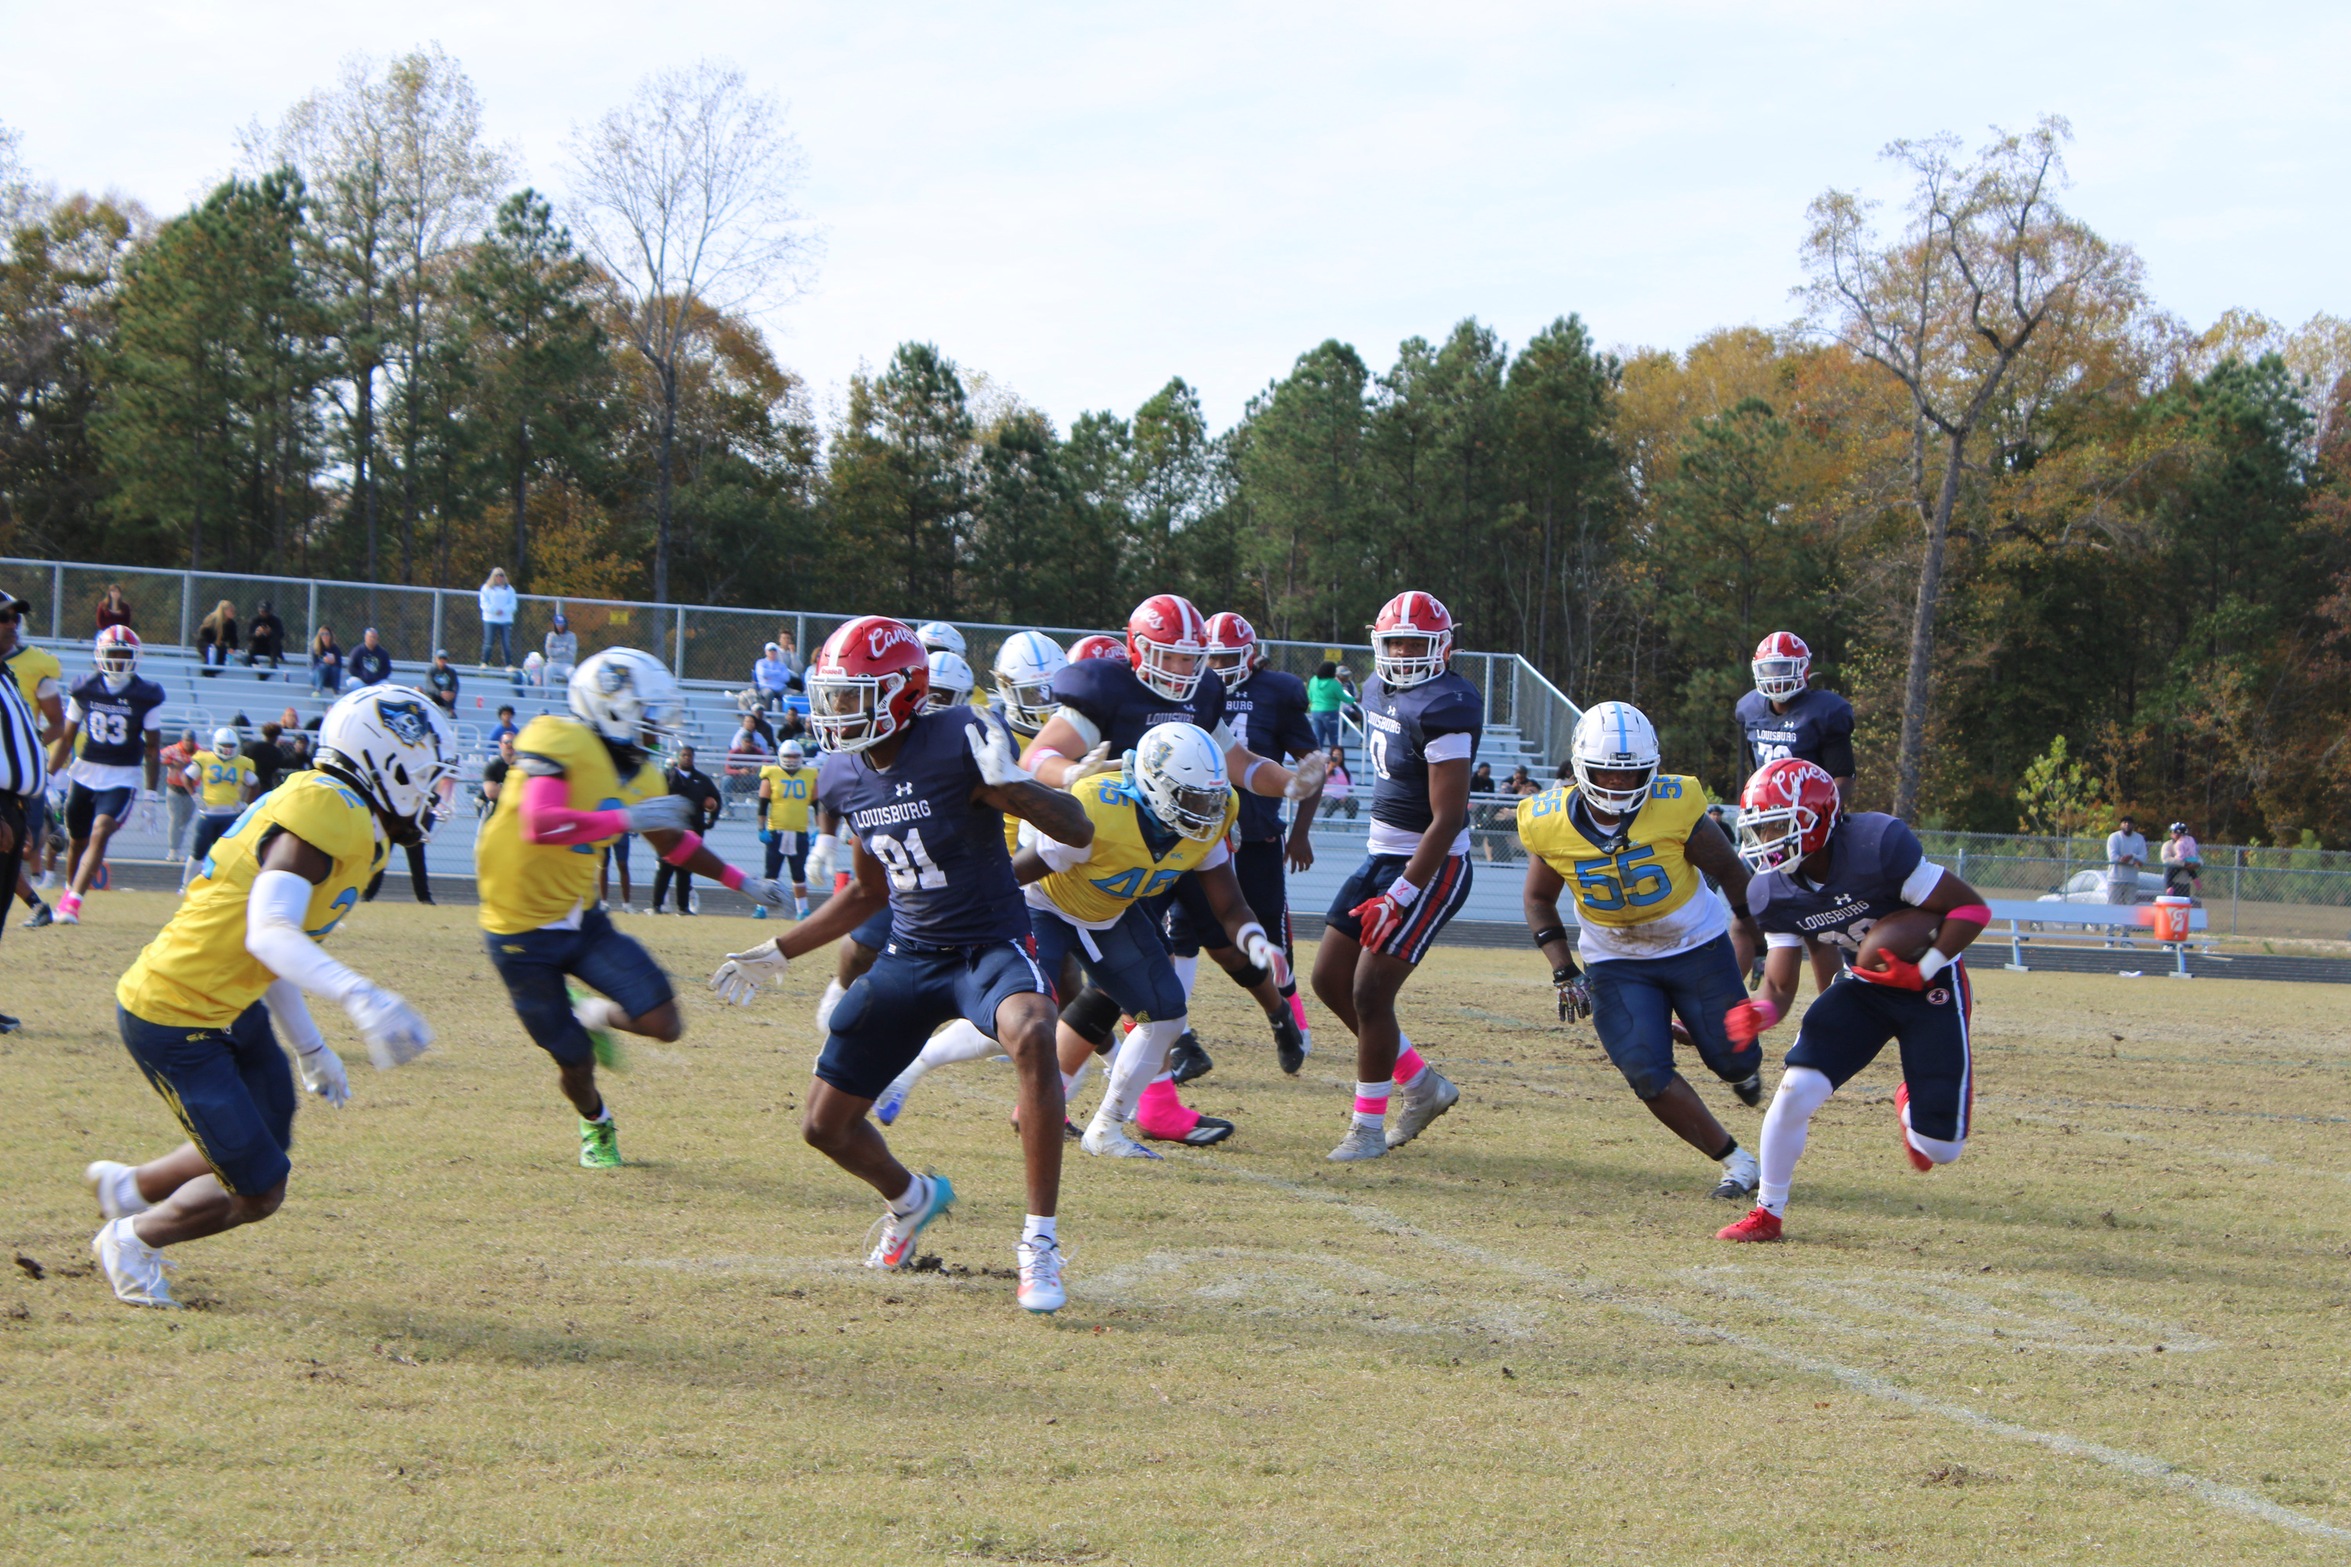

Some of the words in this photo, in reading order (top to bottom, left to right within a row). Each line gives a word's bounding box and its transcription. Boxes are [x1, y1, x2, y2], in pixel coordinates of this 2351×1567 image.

[89, 711, 128, 745] 83
[1756, 728, 1797, 743] LOUISBURG
[1369, 729, 1391, 781] 0
[208, 764, 238, 785] 34
[780, 779, 807, 800] 70
[852, 799, 932, 828] LOUISBURG
[1574, 845, 1672, 911] 55
[1796, 900, 1870, 931] LOUISBURG
